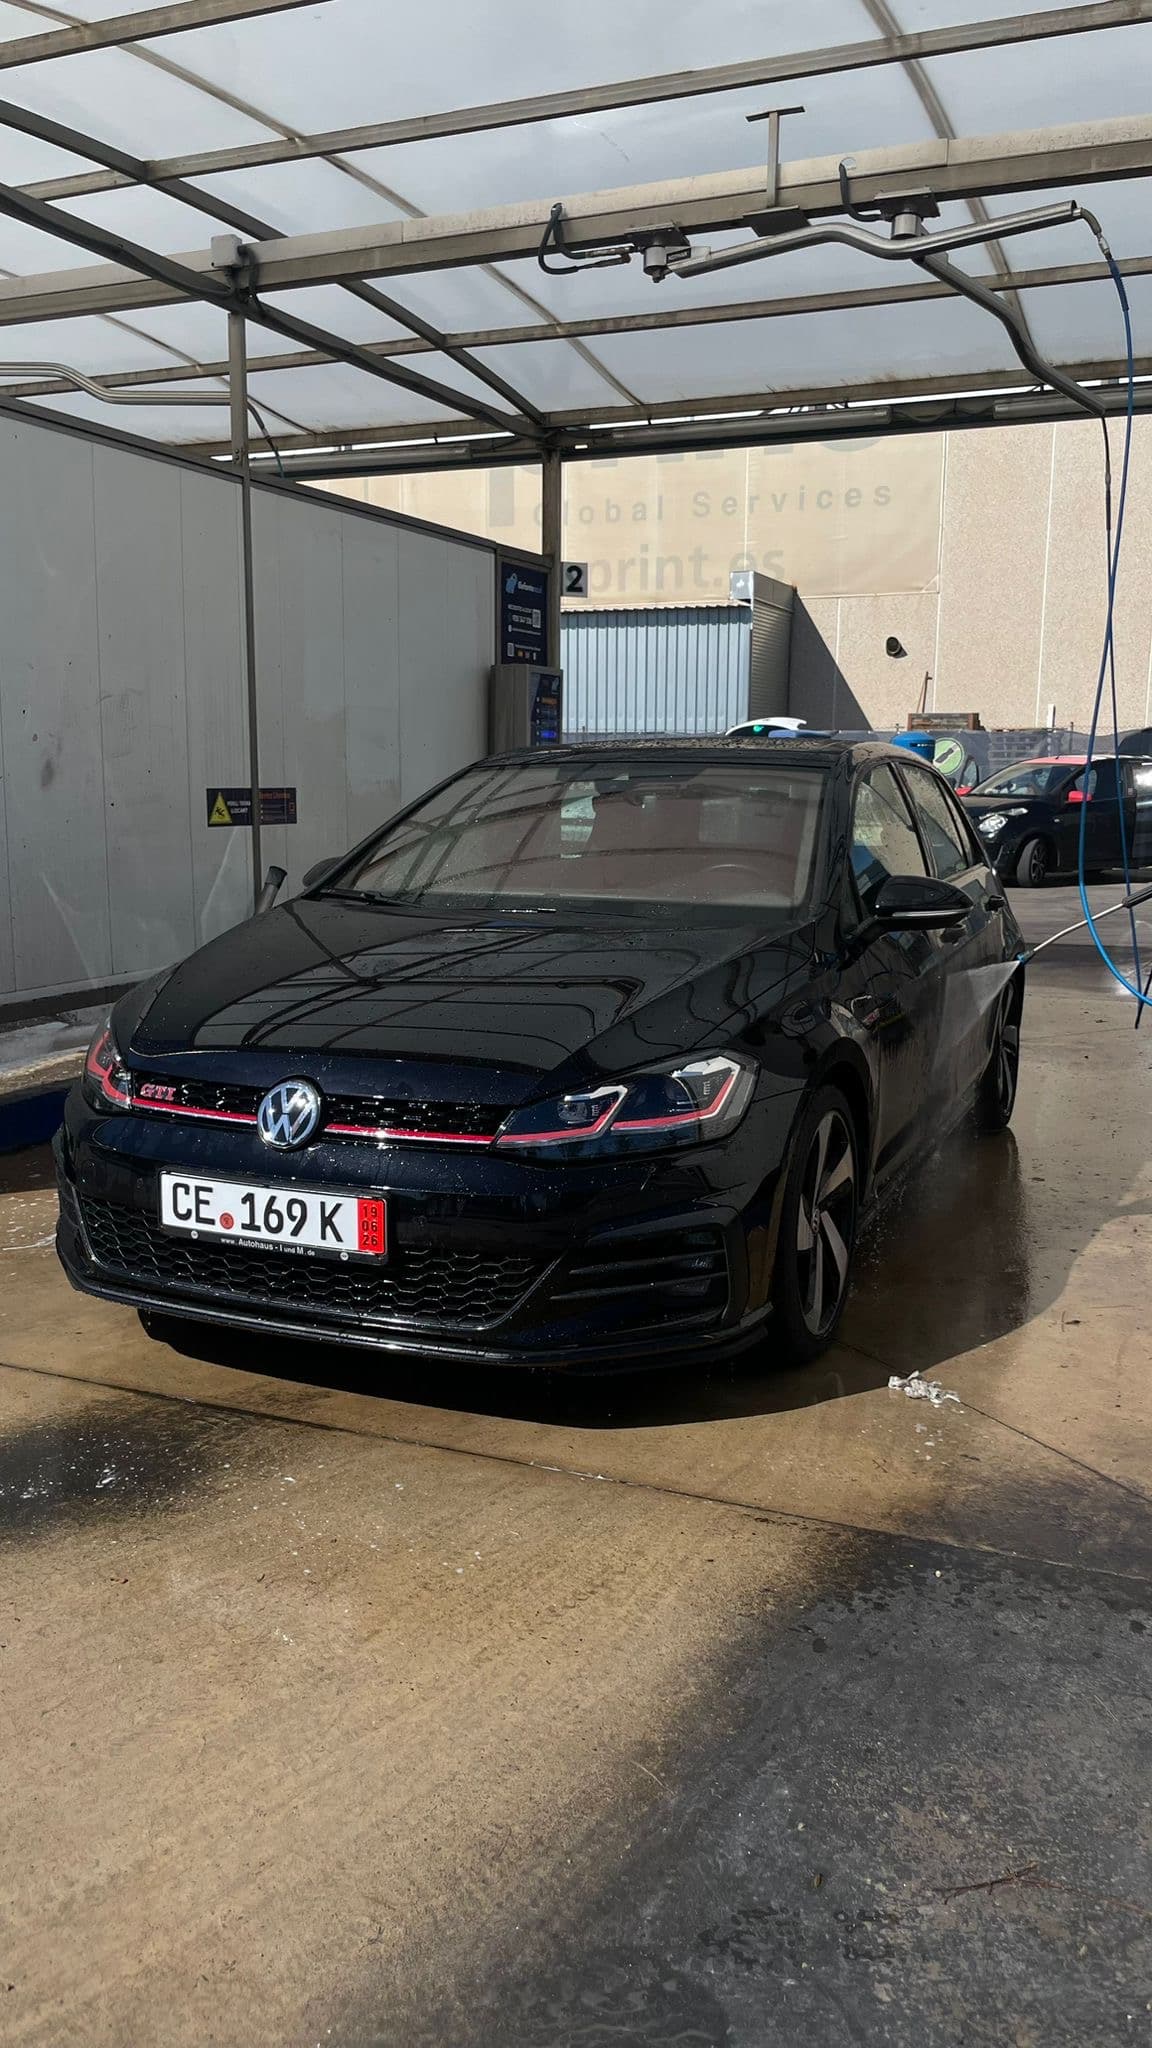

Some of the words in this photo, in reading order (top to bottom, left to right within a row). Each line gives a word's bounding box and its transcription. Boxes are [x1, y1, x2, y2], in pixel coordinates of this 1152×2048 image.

[534, 494, 664, 526] lobal
[692, 484, 891, 518] Services
[566, 565, 583, 593] 2
[140, 1084, 176, 1101] GTI
[171, 1181, 215, 1226] CE
[240, 1191, 308, 1238] 169
[363, 1205, 378, 1218] 19
[362, 1219, 378, 1233] 06
[363, 1234, 378, 1247] 26
